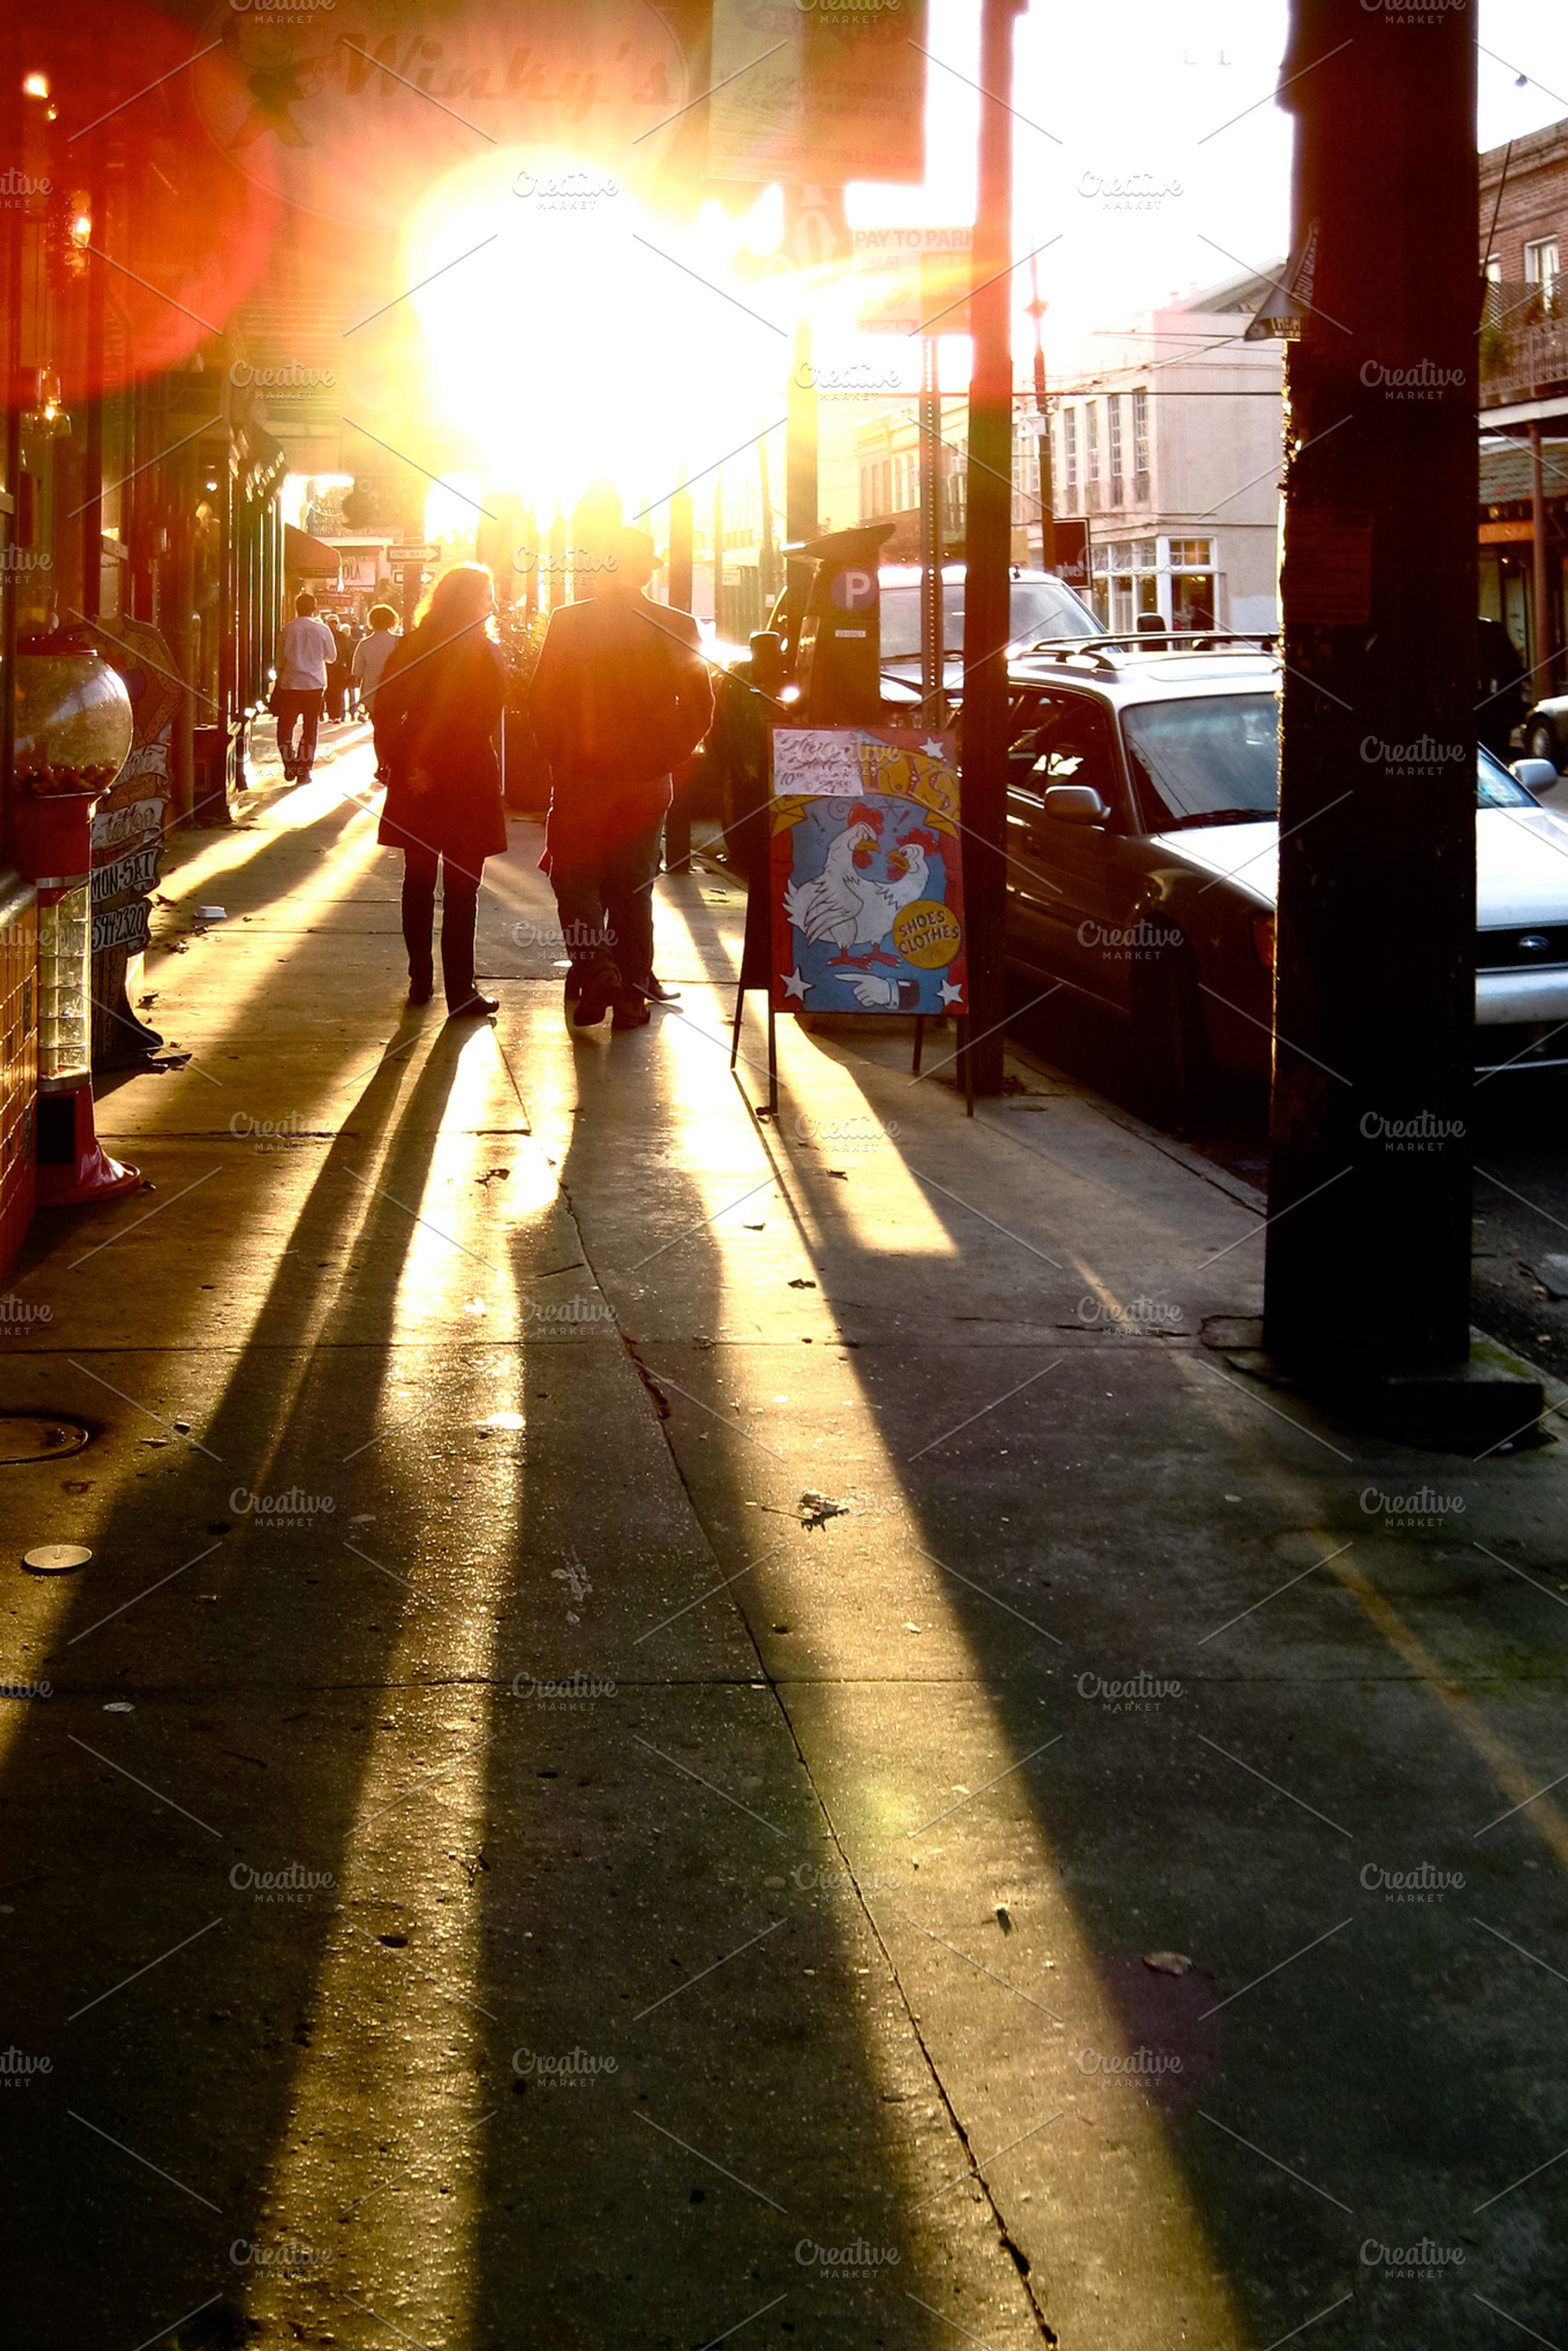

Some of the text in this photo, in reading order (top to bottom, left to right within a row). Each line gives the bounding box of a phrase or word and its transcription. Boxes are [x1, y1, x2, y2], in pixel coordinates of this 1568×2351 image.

[333, 30, 682, 123] Winky's
[855, 230, 890, 248] PAY
[894, 229, 922, 248] TO
[845, 571, 871, 610] P
[104, 805, 155, 844] tattoo
[899, 910, 946, 937] SHOES
[899, 925, 961, 955] CLOTHES
